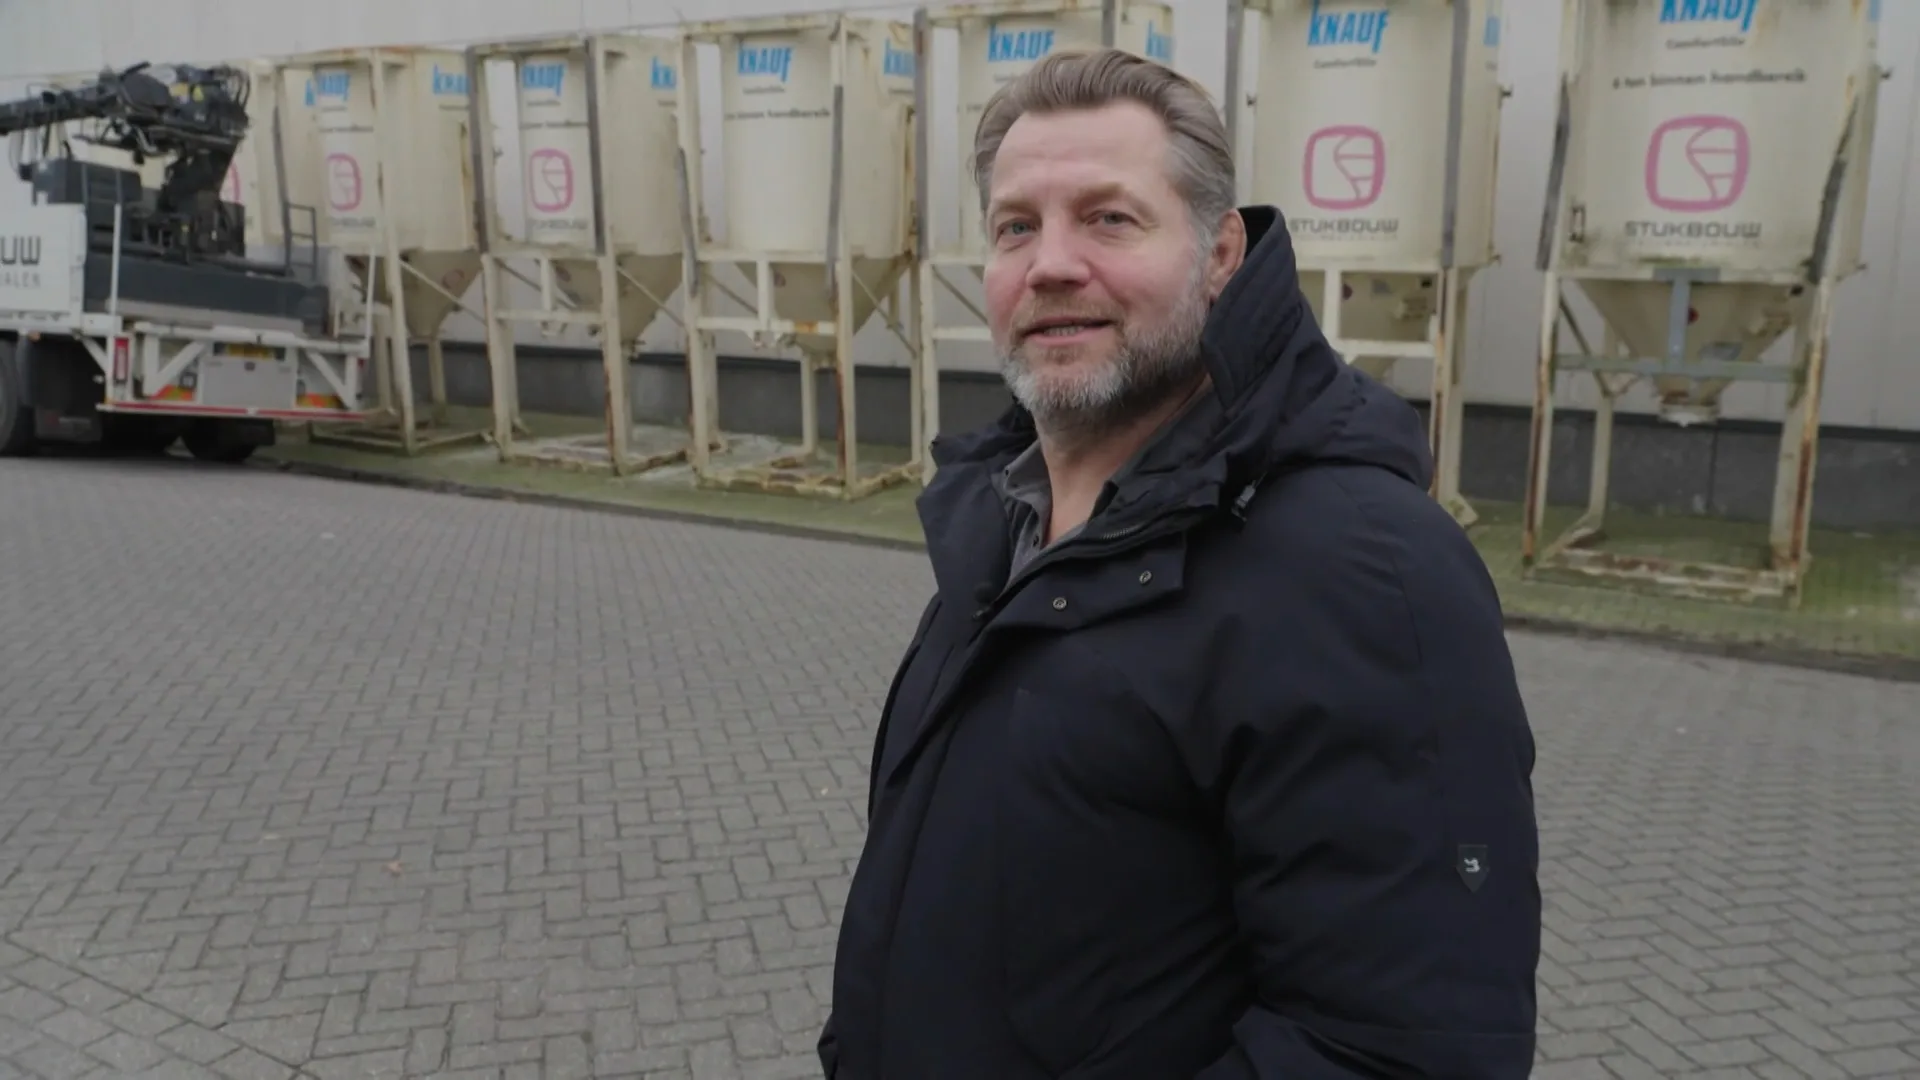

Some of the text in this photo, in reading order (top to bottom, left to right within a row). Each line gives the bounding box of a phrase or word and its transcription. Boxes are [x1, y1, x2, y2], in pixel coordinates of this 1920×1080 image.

[1307, 0, 1390, 54] KNAUF
[1288, 217, 1400, 234] STUKBOUW
[1624, 220, 1762, 239] STUKBOUW
